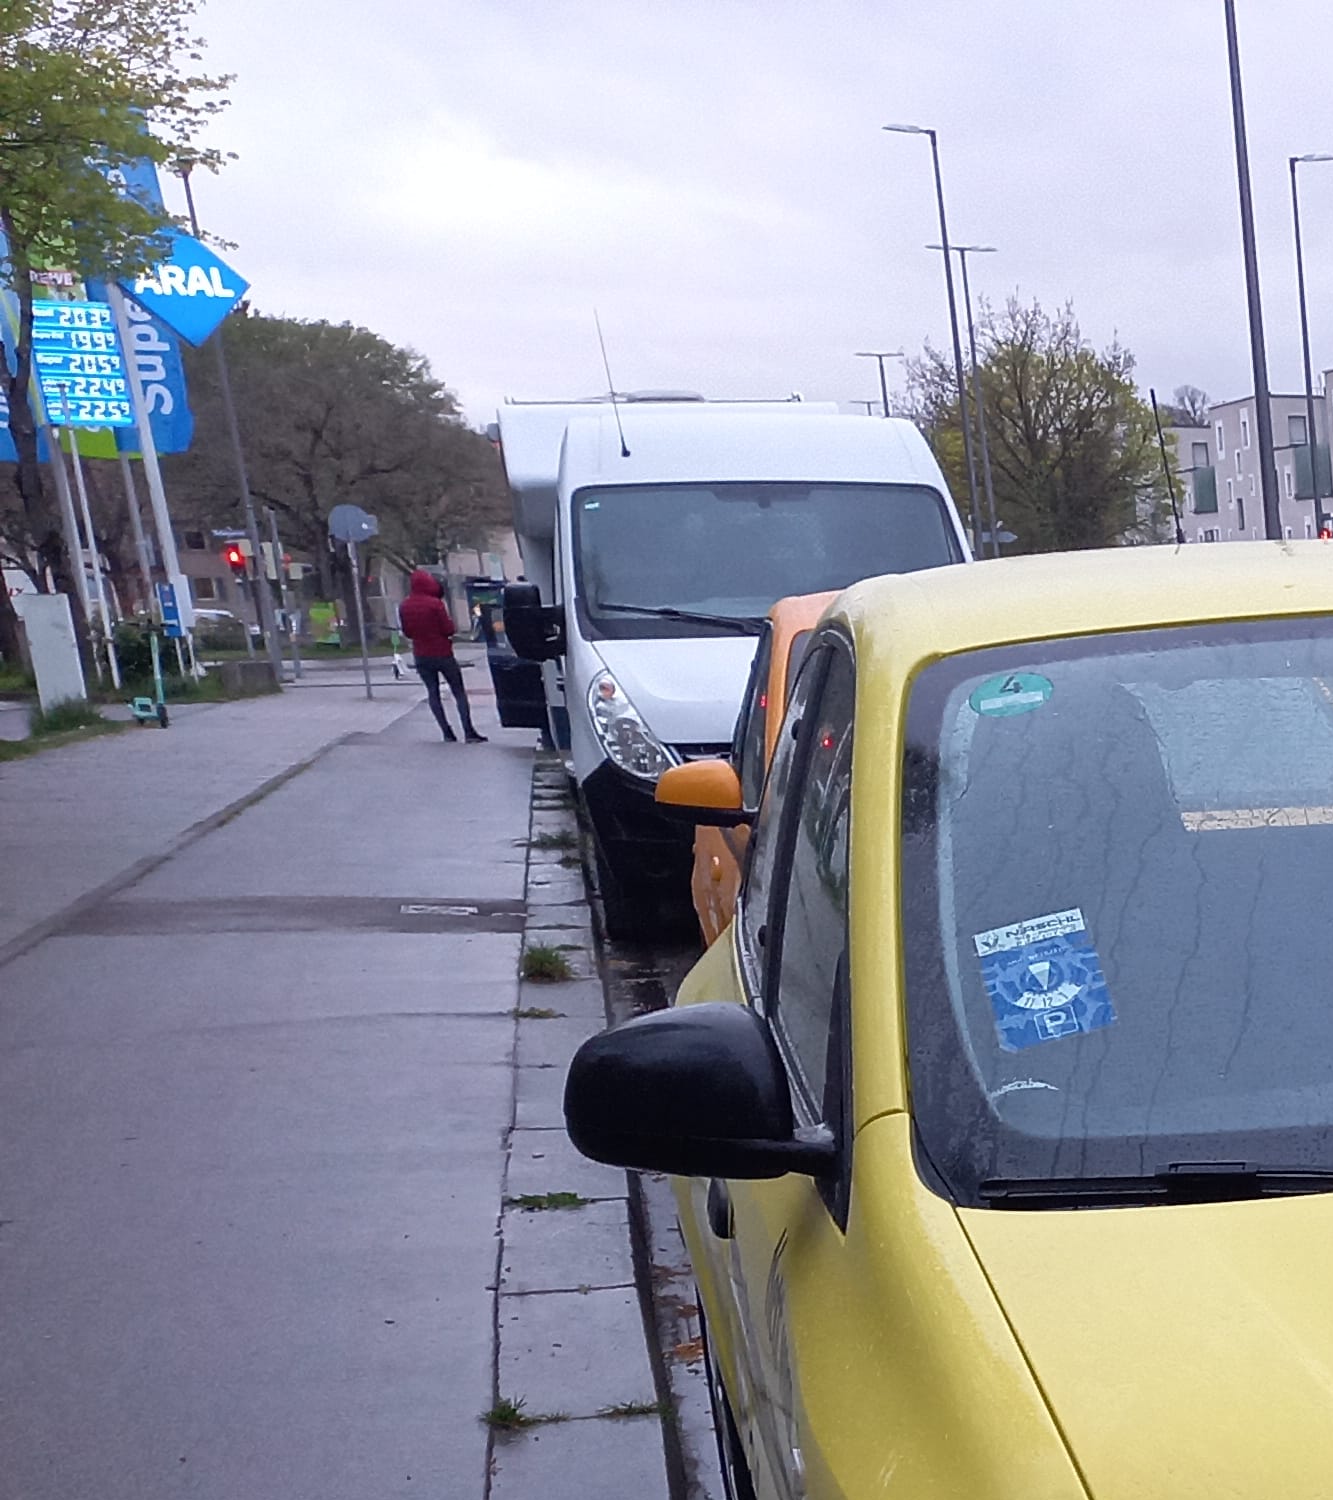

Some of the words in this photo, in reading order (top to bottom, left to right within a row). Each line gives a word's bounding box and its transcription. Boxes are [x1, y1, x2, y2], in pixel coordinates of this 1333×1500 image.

[135, 265, 236, 298] ARAL
[123, 297, 174, 415] Supe
[1000, 676, 1023, 693] 4
[1044, 1011, 1067, 1034] P
